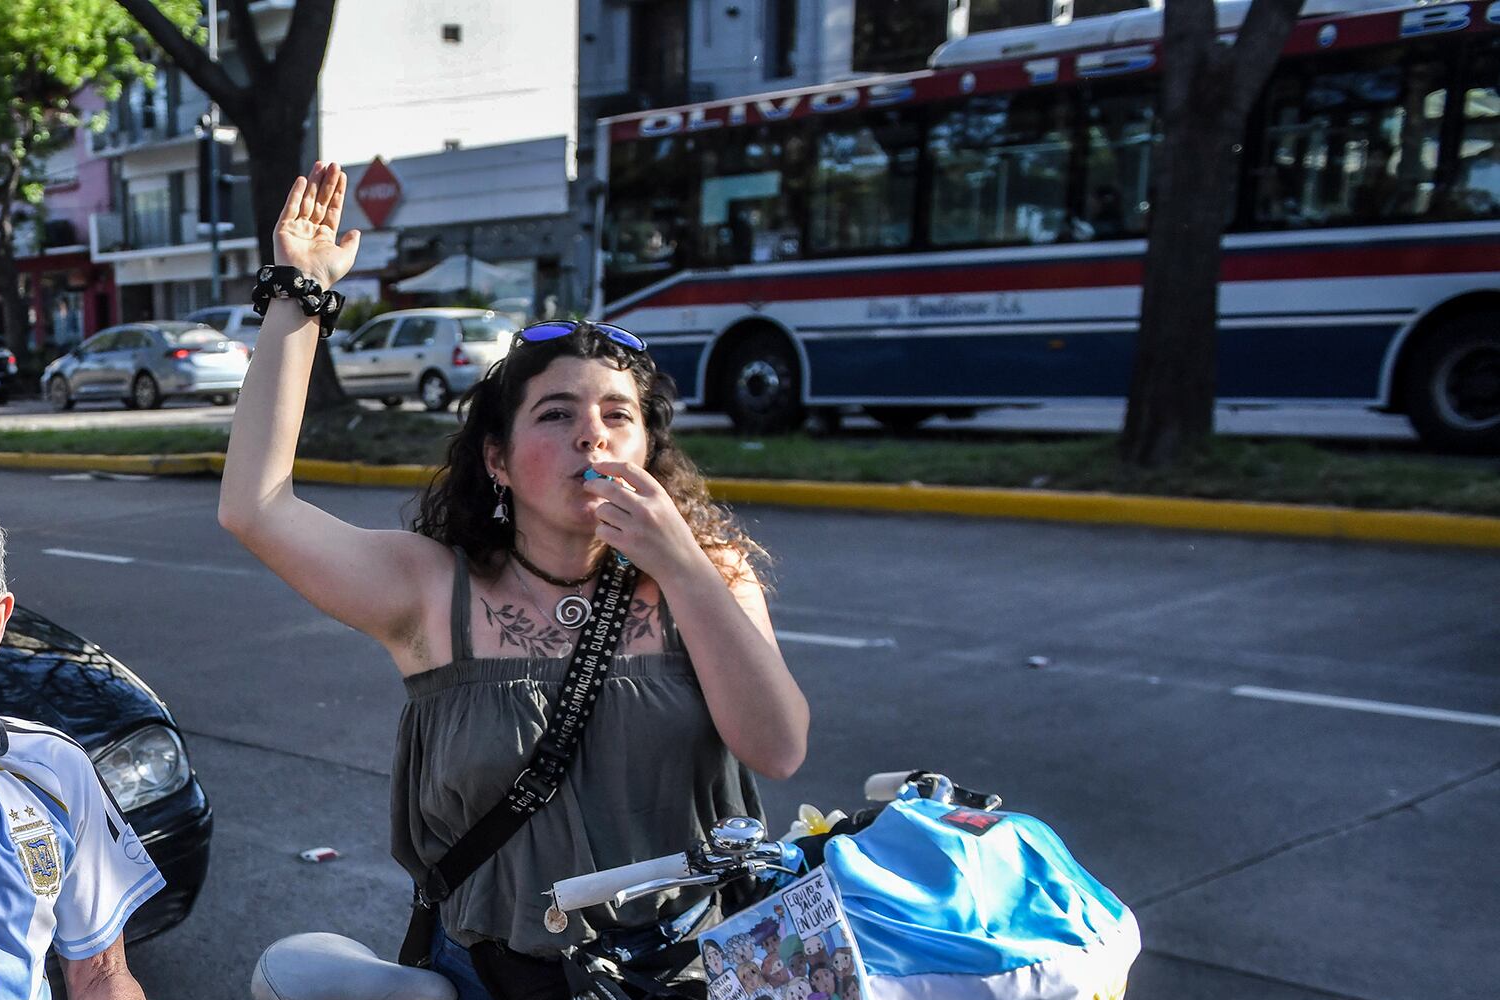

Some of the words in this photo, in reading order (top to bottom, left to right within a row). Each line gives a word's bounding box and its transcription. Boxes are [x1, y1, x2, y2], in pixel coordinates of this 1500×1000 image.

[638, 83, 915, 138] OLIVOS
[605, 589, 621, 611] COOL
[601, 610, 613, 620] &
[590, 619, 609, 651] CLASSY
[570, 655, 599, 713] SANTACLARA
[785, 885, 814, 907] EQUIPO
[800, 891, 821, 915] SALUD
[807, 899, 838, 927] LUCHA
